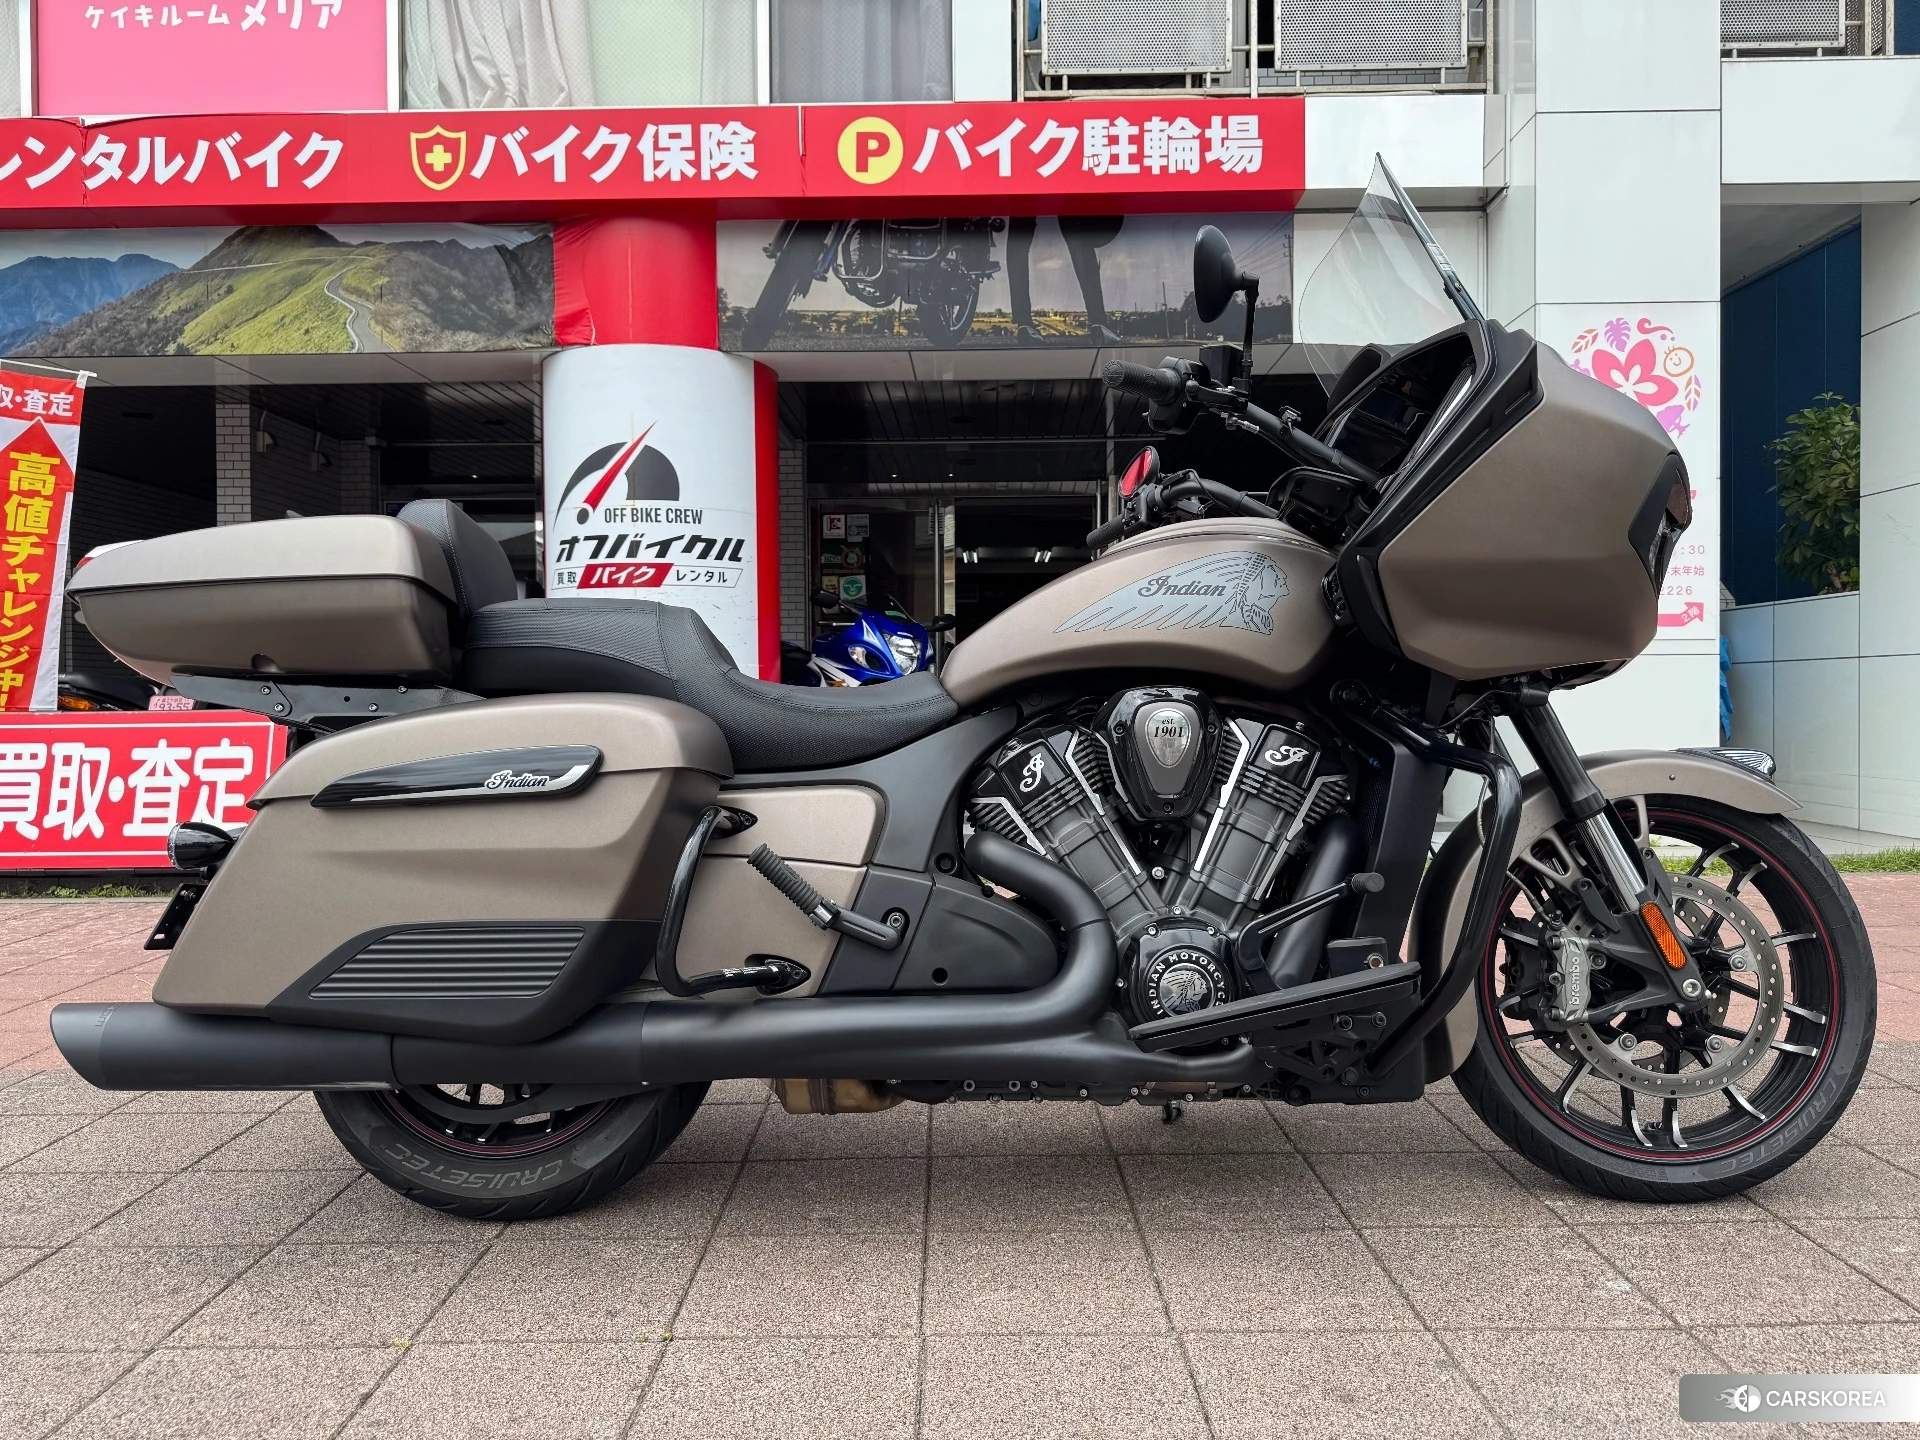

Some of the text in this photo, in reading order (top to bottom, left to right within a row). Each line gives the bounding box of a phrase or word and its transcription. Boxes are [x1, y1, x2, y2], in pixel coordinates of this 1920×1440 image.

[85, 0, 342, 31] ケイキルーム メリア
[469, 121, 759, 183] バイク保険
[912, 114, 1263, 177] バイク駐輪場
[604, 507, 703, 524] OFF BIKE CREW
[555, 532, 746, 563] オフバイクル
[557, 566, 728, 586] 買取 バイク レンタル
[1137, 575, 1227, 597] Indian
[1667, 565, 1705, 576] 末年始
[1681, 606, 1700, 623] 2階
[1154, 726, 1184, 738] 1901
[0, 737, 254, 841] 買取・査定
[485, 770, 549, 790] Indian
[1569, 956, 1580, 1006] brembo
[1719, 1077, 1837, 1174] CRUISETEC
[384, 1143, 563, 1190] CRUISETEC
